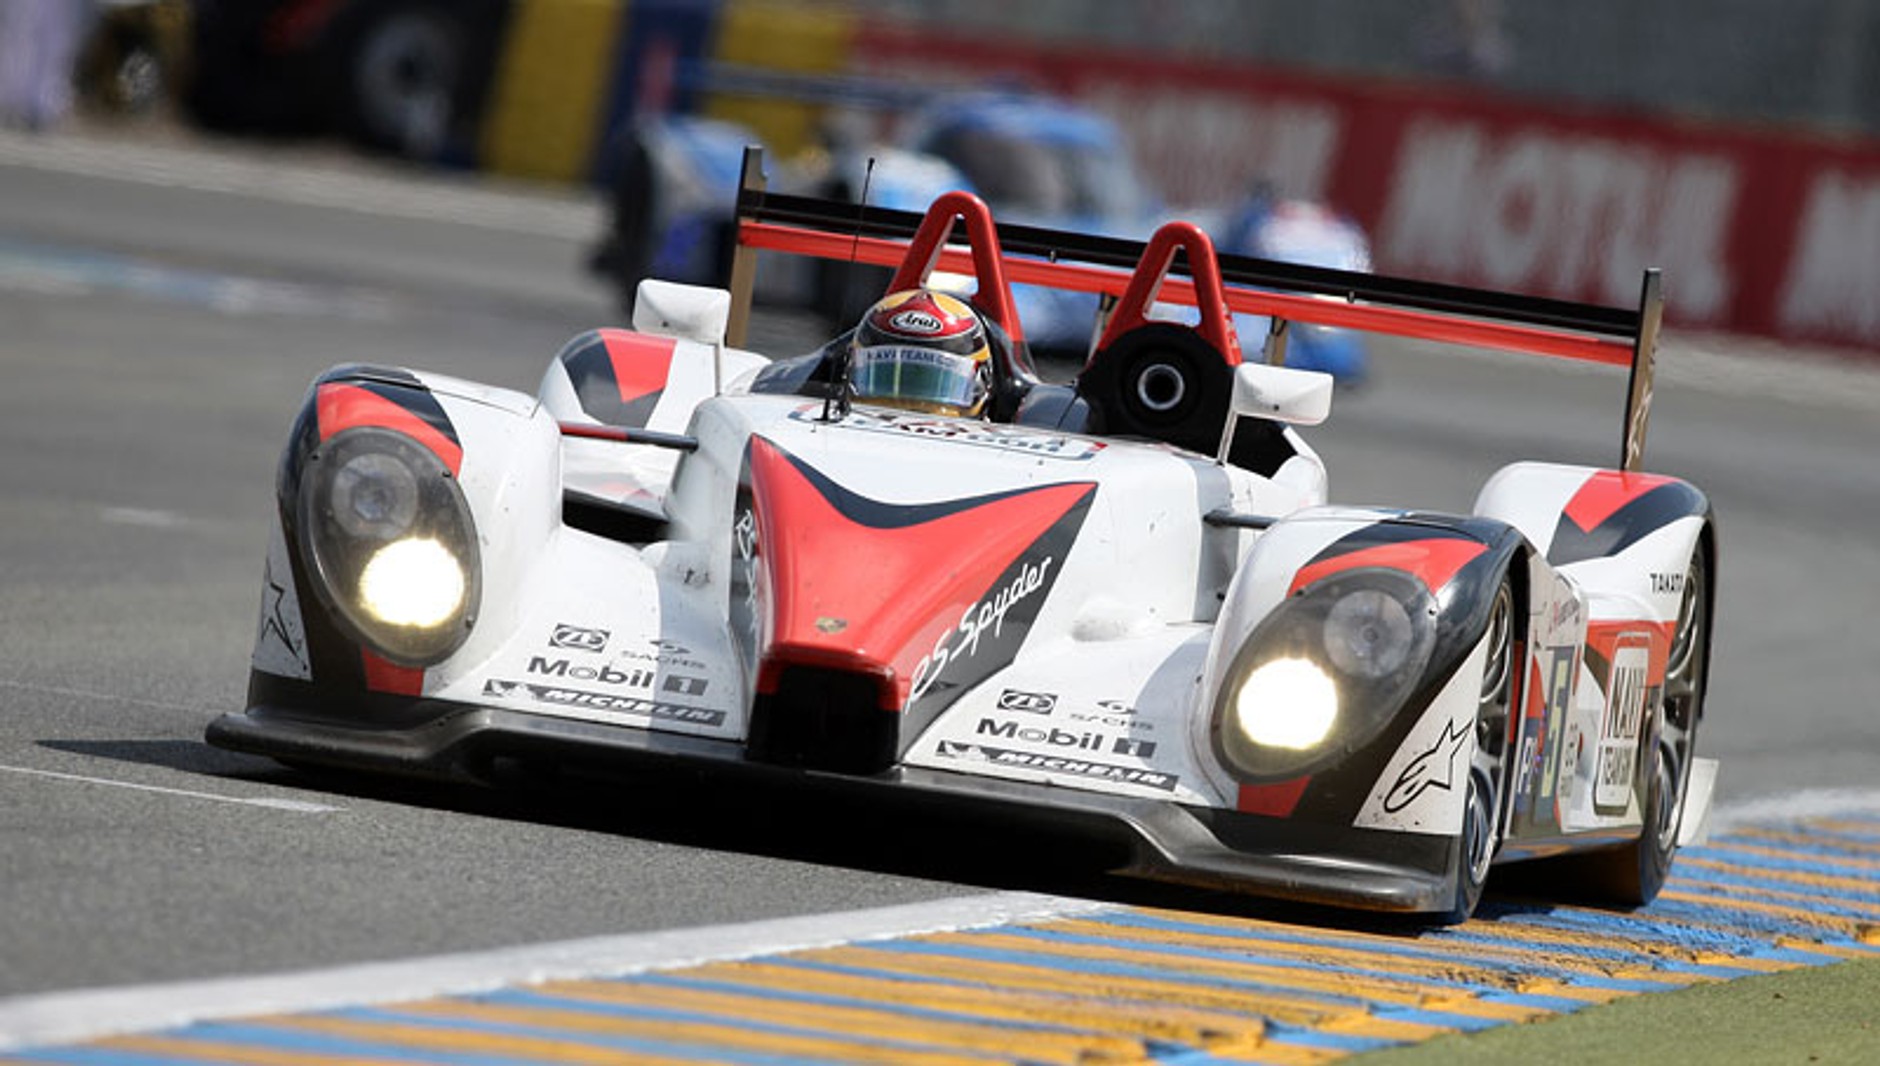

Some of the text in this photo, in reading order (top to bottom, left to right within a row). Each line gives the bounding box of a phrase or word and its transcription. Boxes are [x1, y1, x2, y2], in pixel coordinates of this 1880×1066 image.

[904, 556, 1052, 716] RS Spyder
[527, 655, 656, 690] Mobil
[544, 687, 717, 723] MICHELIN
[975, 717, 1104, 751] Mobil
[994, 750, 1169, 787] MICHELIN
